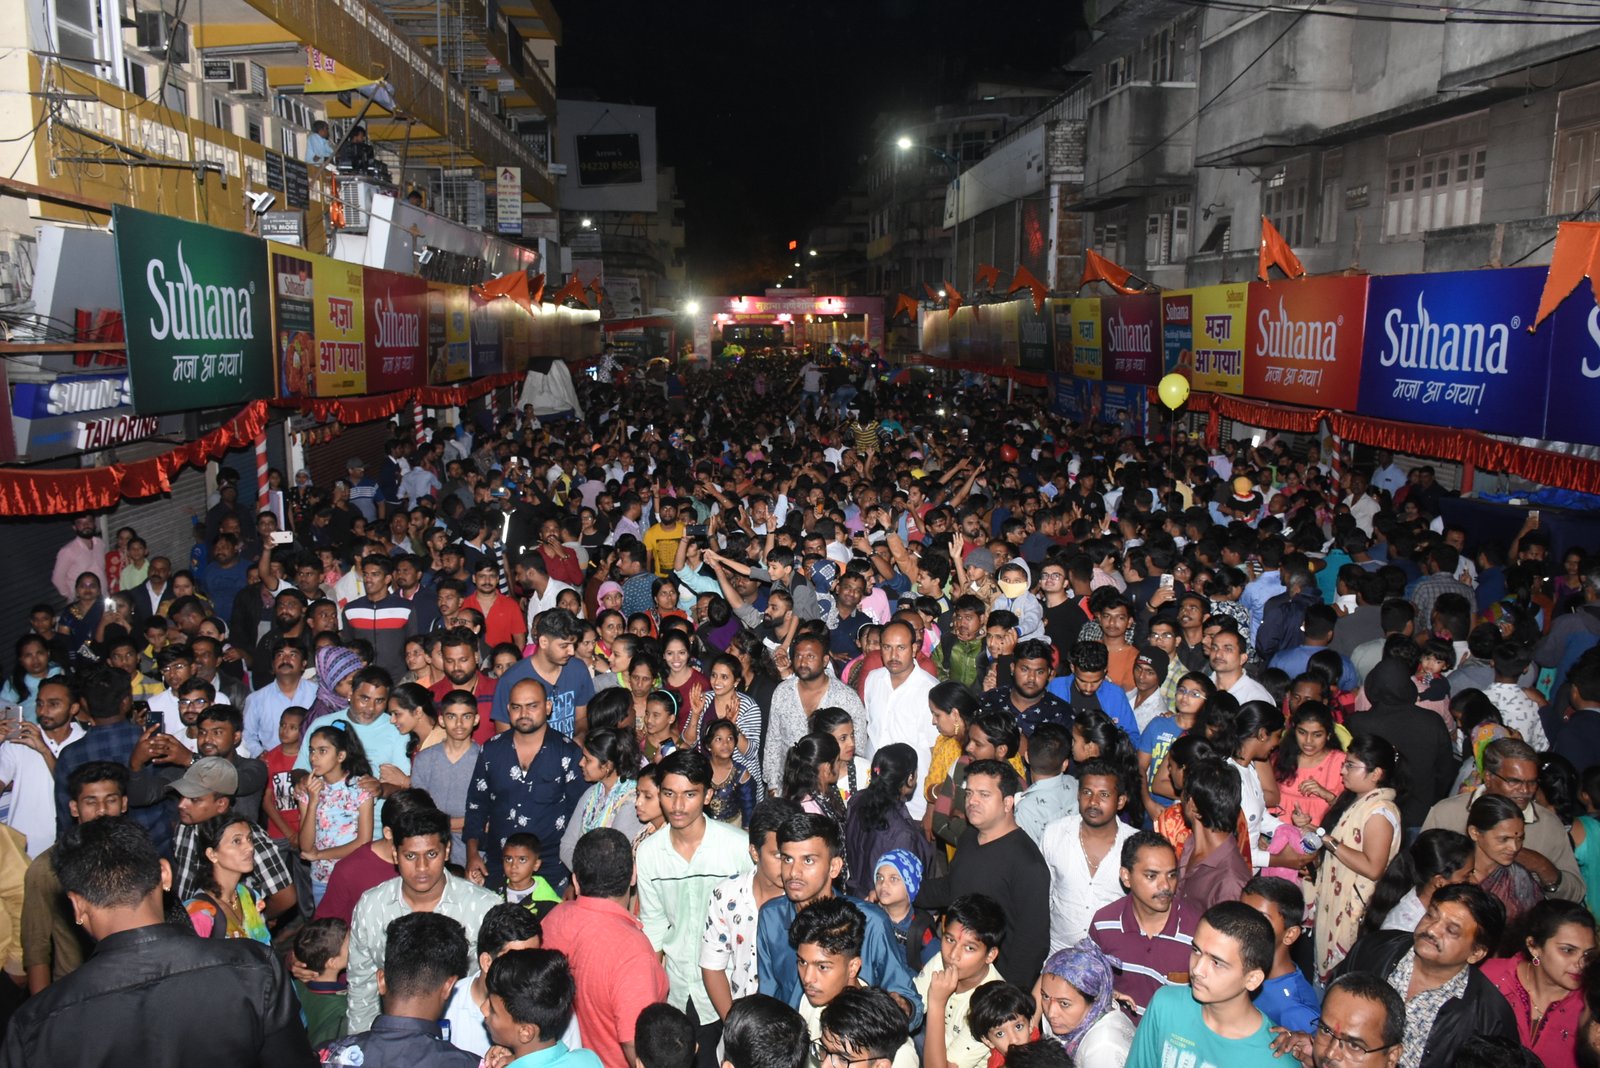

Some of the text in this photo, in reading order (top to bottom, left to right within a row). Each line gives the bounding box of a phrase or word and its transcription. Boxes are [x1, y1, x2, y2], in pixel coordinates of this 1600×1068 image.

[328, 297, 353, 335] मज़ा
[1205, 314, 1232, 344] मज़ा
[338, 342, 365, 374] गया!
[1212, 350, 1242, 376] गया!
[1392, 378, 1424, 402] मज़ा
[1445, 382, 1486, 414] गया!
[77, 415, 159, 450] TAILORING
